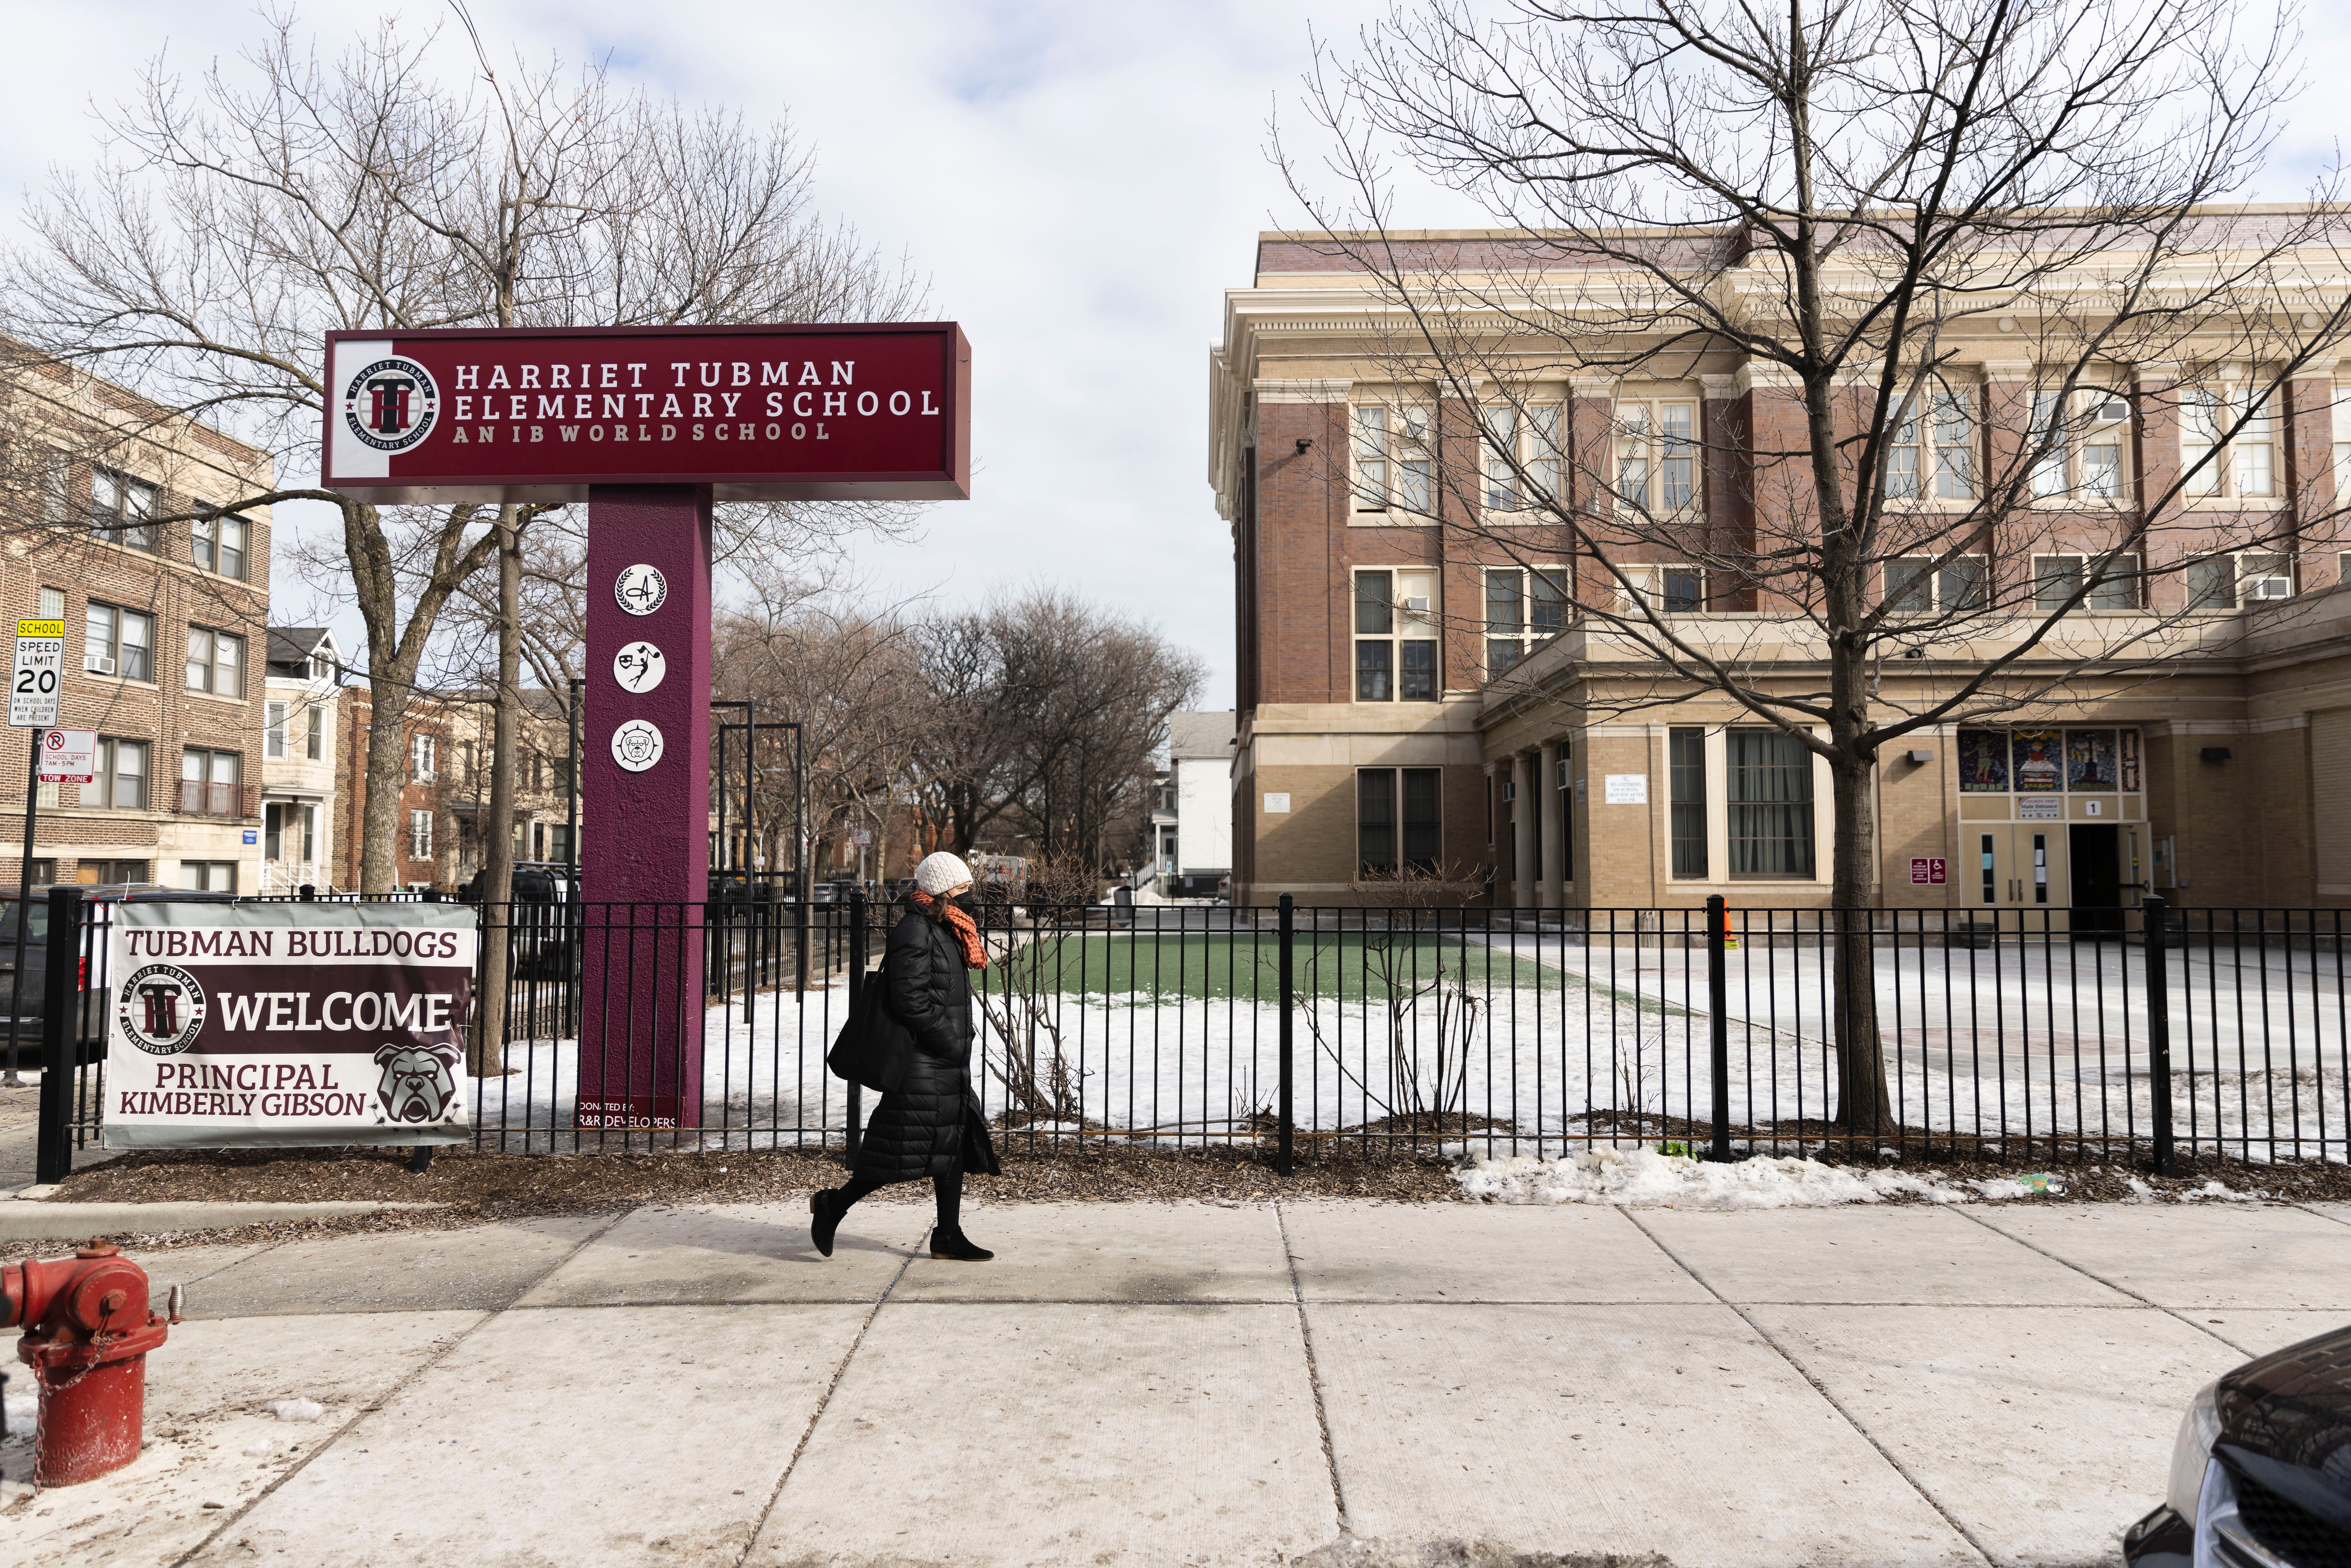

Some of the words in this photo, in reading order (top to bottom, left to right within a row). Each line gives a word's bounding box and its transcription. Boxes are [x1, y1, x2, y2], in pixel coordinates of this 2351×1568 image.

[351, 362, 390, 392] HARRIET
[397, 362, 432, 392] TUBMAN
[456, 364, 646, 389] HARRIET
[671, 361, 854, 386] TUBMAN
[455, 392, 741, 420] ELEMENTARY
[767, 391, 939, 417] SCHOOL
[349, 417, 399, 449] ELEMENTARY
[403, 417, 431, 445] SCHOOL
[453, 426, 494, 443] AN
[513, 426, 543, 442] IB
[560, 425, 676, 442] WORLD
[693, 423, 828, 440] SCHOOL
[20, 623, 62, 633] SCHOOL
[20, 642, 60, 652] SPEED
[22, 656, 55, 666] LIMIT
[17, 669, 56, 694] 20
[2090, 803, 2096, 813] 1
[126, 931, 273, 956] TUBMAN
[288, 931, 457, 958] BULLDOGS
[124, 966, 158, 996] HARRIET
[164, 967, 200, 998] TUBMAN
[217, 992, 452, 1032] WELCOME
[123, 1021, 172, 1054] ELEMENTARY
[174, 1023, 199, 1051] SCHOOL
[156, 1063, 338, 1090] PRINCIPAL
[120, 1092, 257, 1116] KIMBERLY
[262, 1093, 366, 1116] GIBSON
[580, 1102, 620, 1111] DONTED
